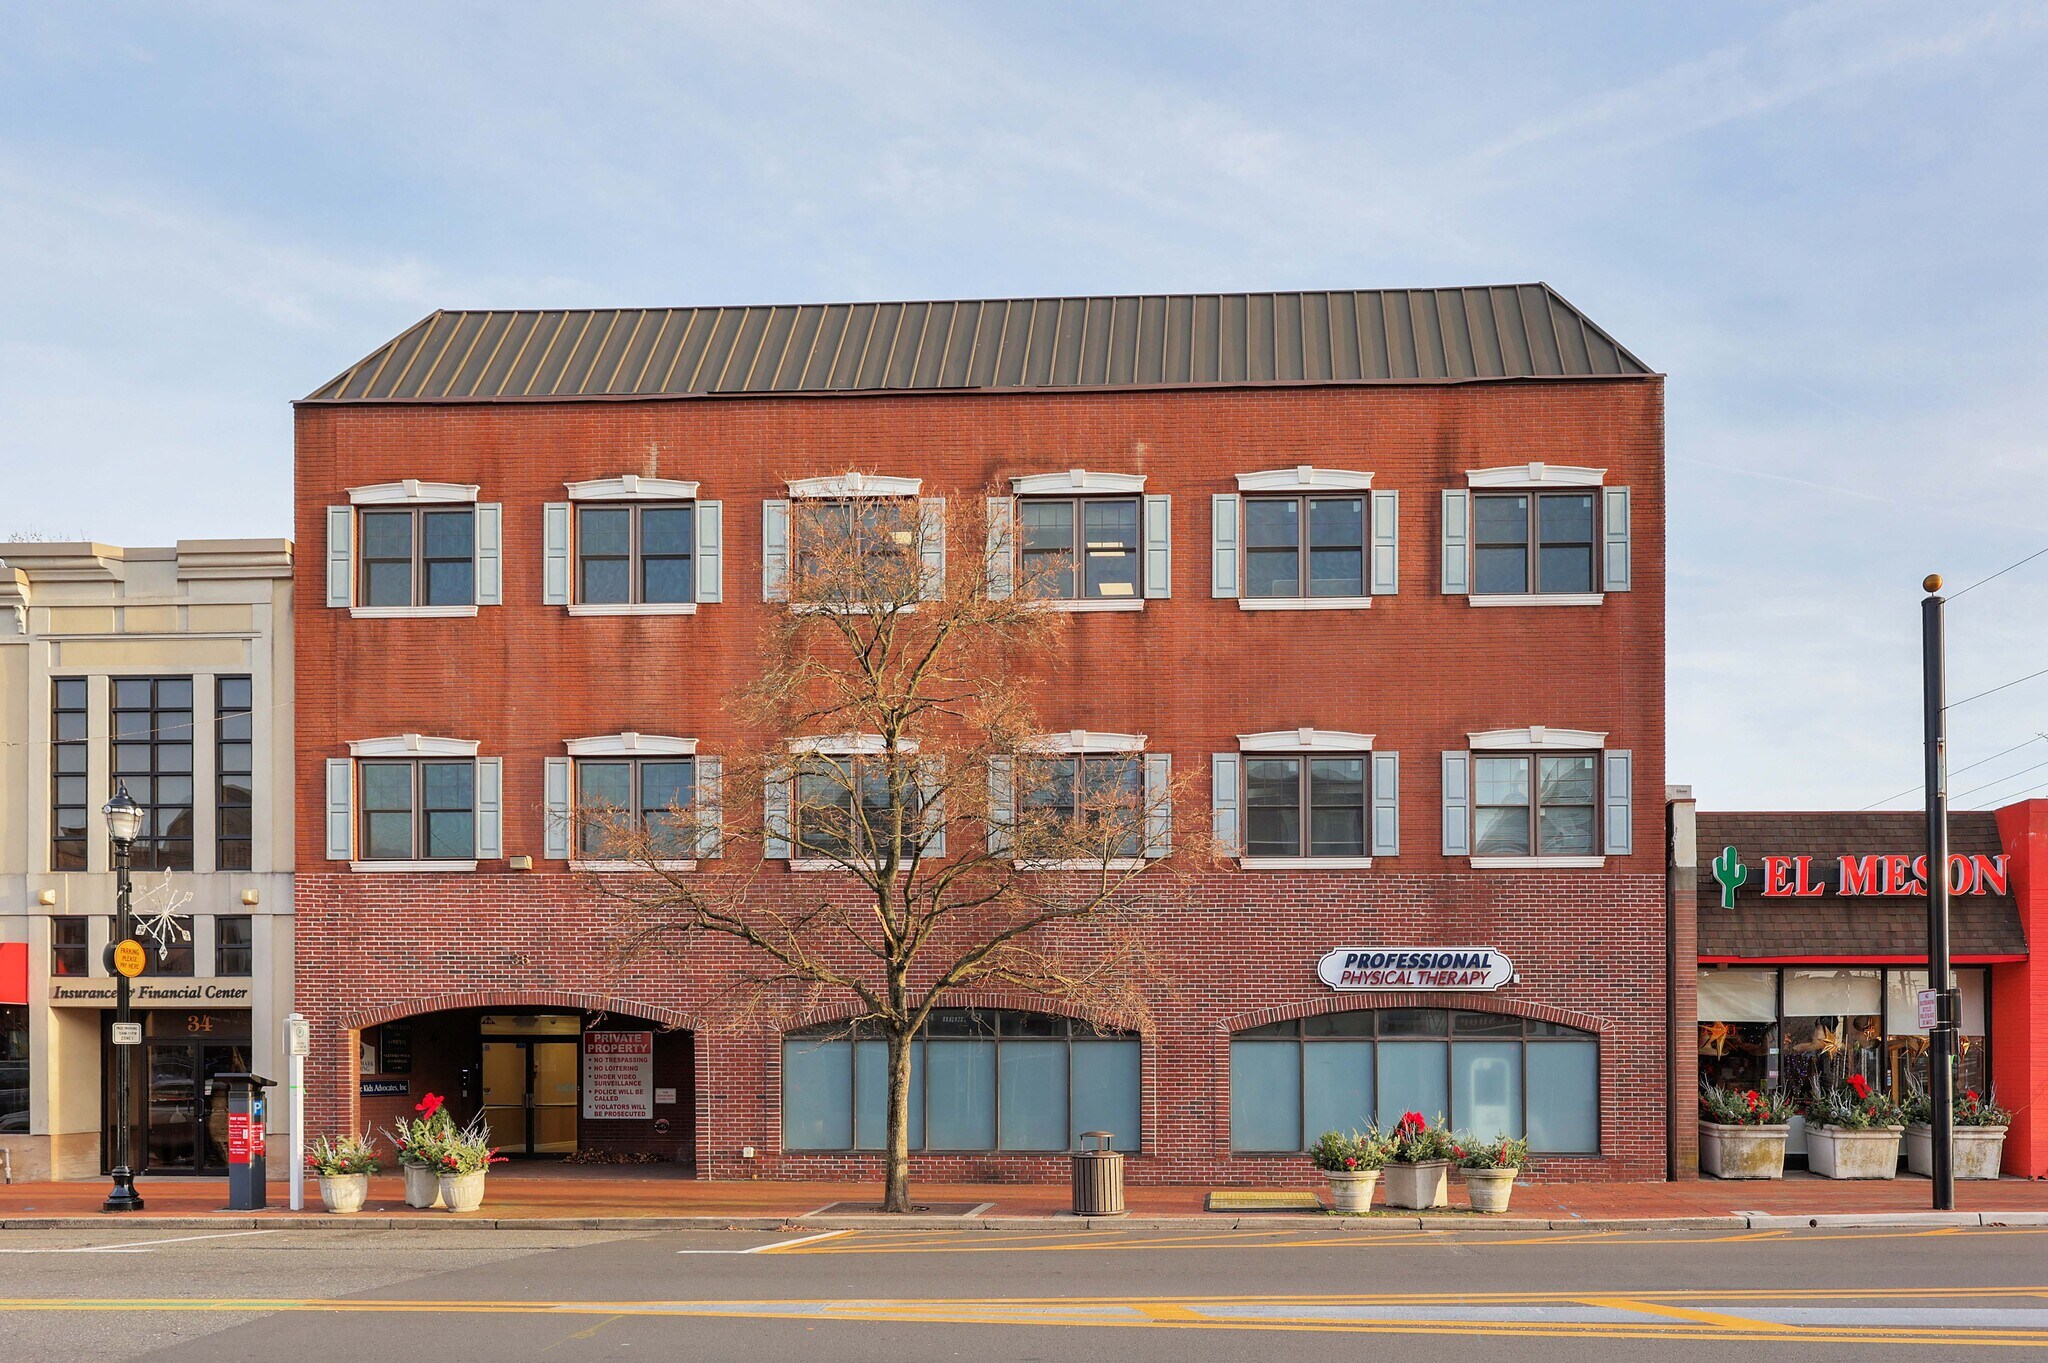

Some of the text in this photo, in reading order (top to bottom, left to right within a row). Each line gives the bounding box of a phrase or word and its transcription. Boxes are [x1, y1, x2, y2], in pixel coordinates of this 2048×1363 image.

[1761, 854, 2011, 897] EL MESON
[120, 947, 140, 956] PARKING
[122, 955, 138, 963] PLEASE
[1344, 953, 1492, 969] PROFESSIONAL
[1340, 970, 1491, 986] PHYSICAL THERAPY
[53, 985, 117, 999] Insurance
[138, 985, 202, 999] Financial
[204, 985, 248, 999] Center
[187, 1014, 213, 1032] 34
[594, 1034, 642, 1043] PRIVATE
[587, 1044, 648, 1053] PROPERTY
[363, 1084, 374, 1092] Kids
[254, 1102, 262, 1114] P
